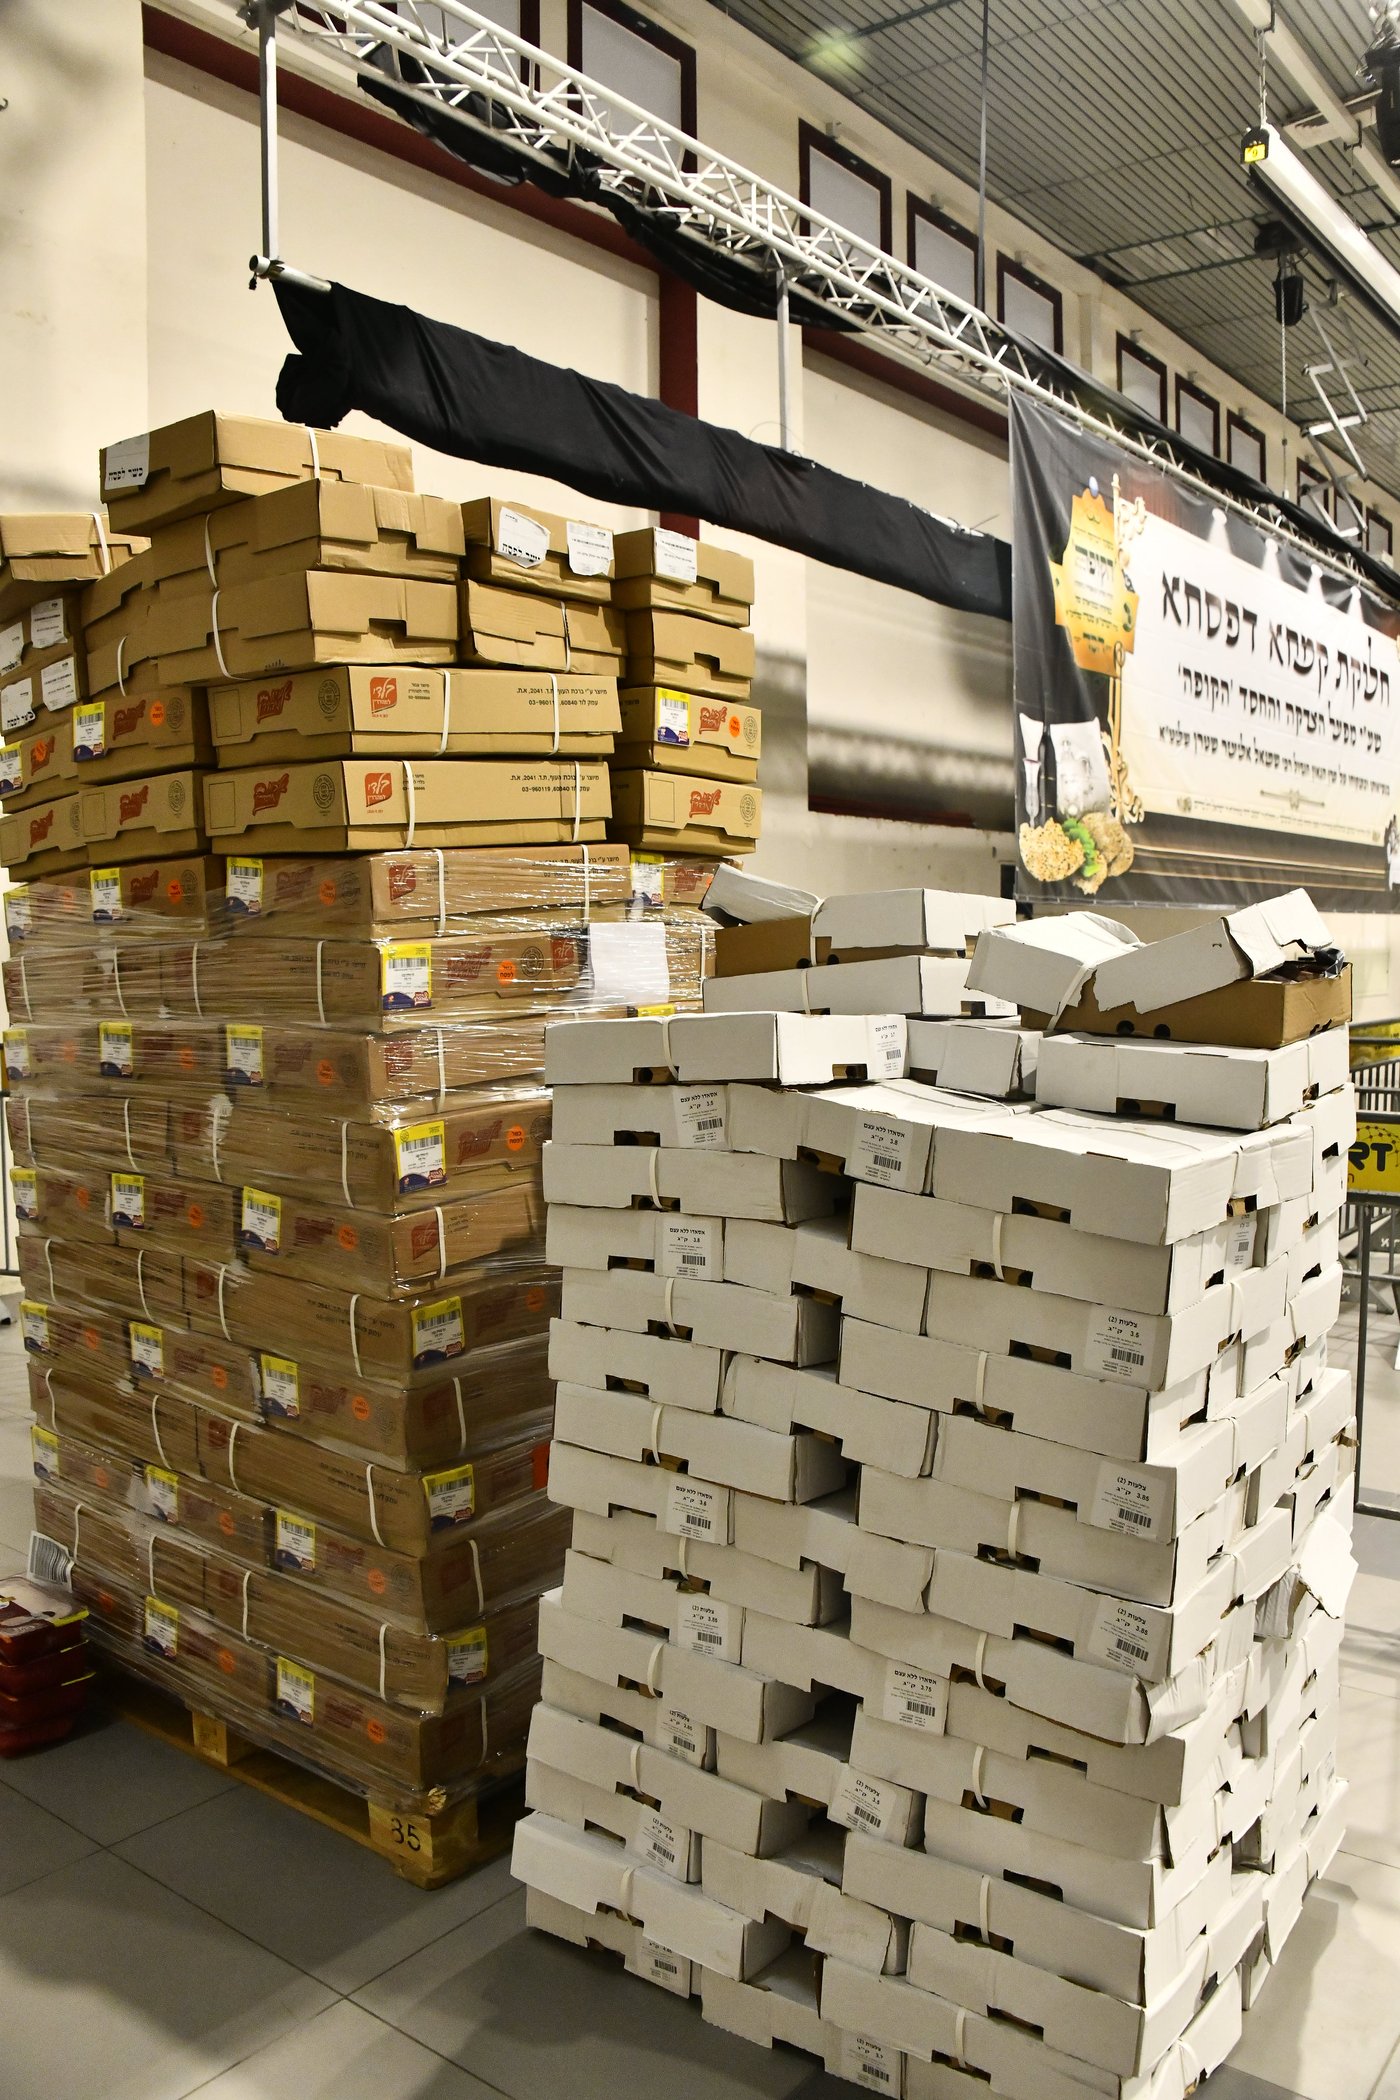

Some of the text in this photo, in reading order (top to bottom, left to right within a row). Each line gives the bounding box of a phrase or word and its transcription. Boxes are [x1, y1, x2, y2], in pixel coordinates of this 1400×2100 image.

[109, 467, 143, 480] כשר לפסח
[1162, 570, 1258, 654] דפסחא
[1269, 619, 1329, 696] קמחא
[1336, 635, 1390, 710] חלוקת
[1239, 686, 1280, 722] והחסד
[1286, 702, 1325, 736] הצדקה
[1328, 701, 1356, 747] מפעל
[1254, 737, 1280, 769] שמואל
[888, 1129, 906, 1138] אסאדו
[1108, 1316, 1138, 1328] צלעות (2)
[697, 1491, 712, 1500] אסאדו
[1117, 1476, 1146, 1491] צלעות (2)
[1118, 1608, 1146, 1625] צלעות (2)
[918, 1676, 936, 1684] אסאדו
[391, 1816, 420, 1851] 35
